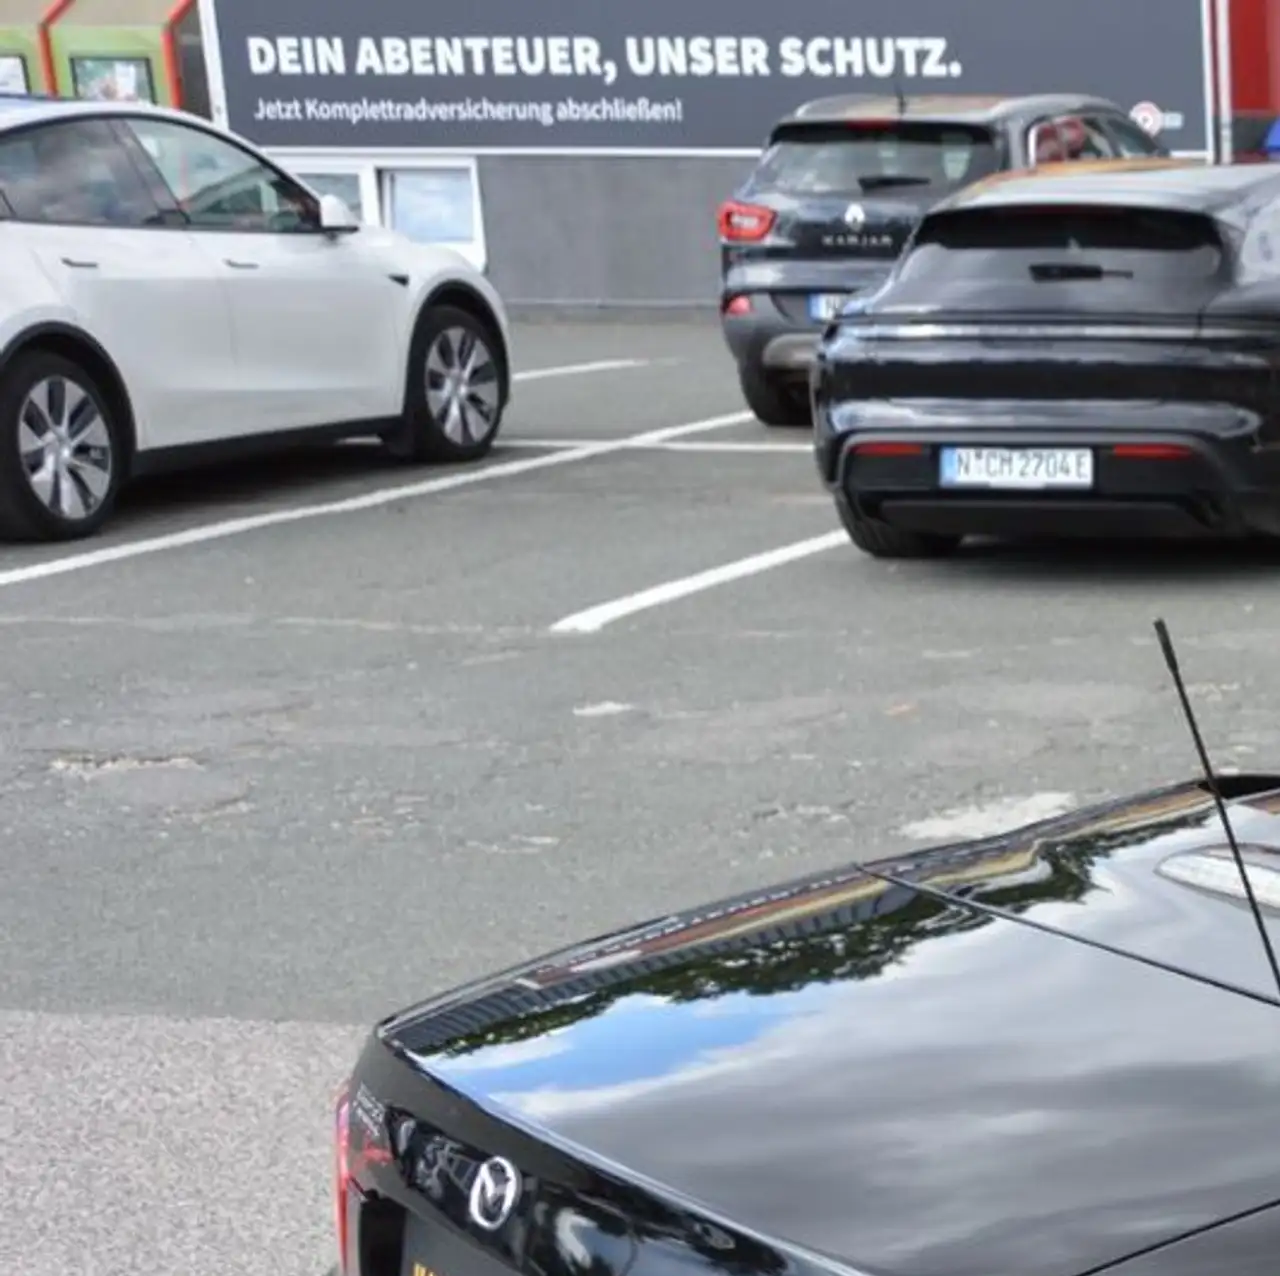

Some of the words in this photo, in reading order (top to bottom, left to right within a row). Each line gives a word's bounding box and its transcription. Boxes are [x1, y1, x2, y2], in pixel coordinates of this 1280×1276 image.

[248, 36, 346, 75] DEIN
[355, 36, 618, 84] ABENTEUER,
[624, 36, 771, 76] UNSER
[779, 36, 963, 78] SCHUTZ.
[254, 97, 302, 121] Jetzt
[304, 96, 554, 125] Komplettradversicherung
[556, 96, 683, 121] abschließen!
[956, 450, 971, 475] N
